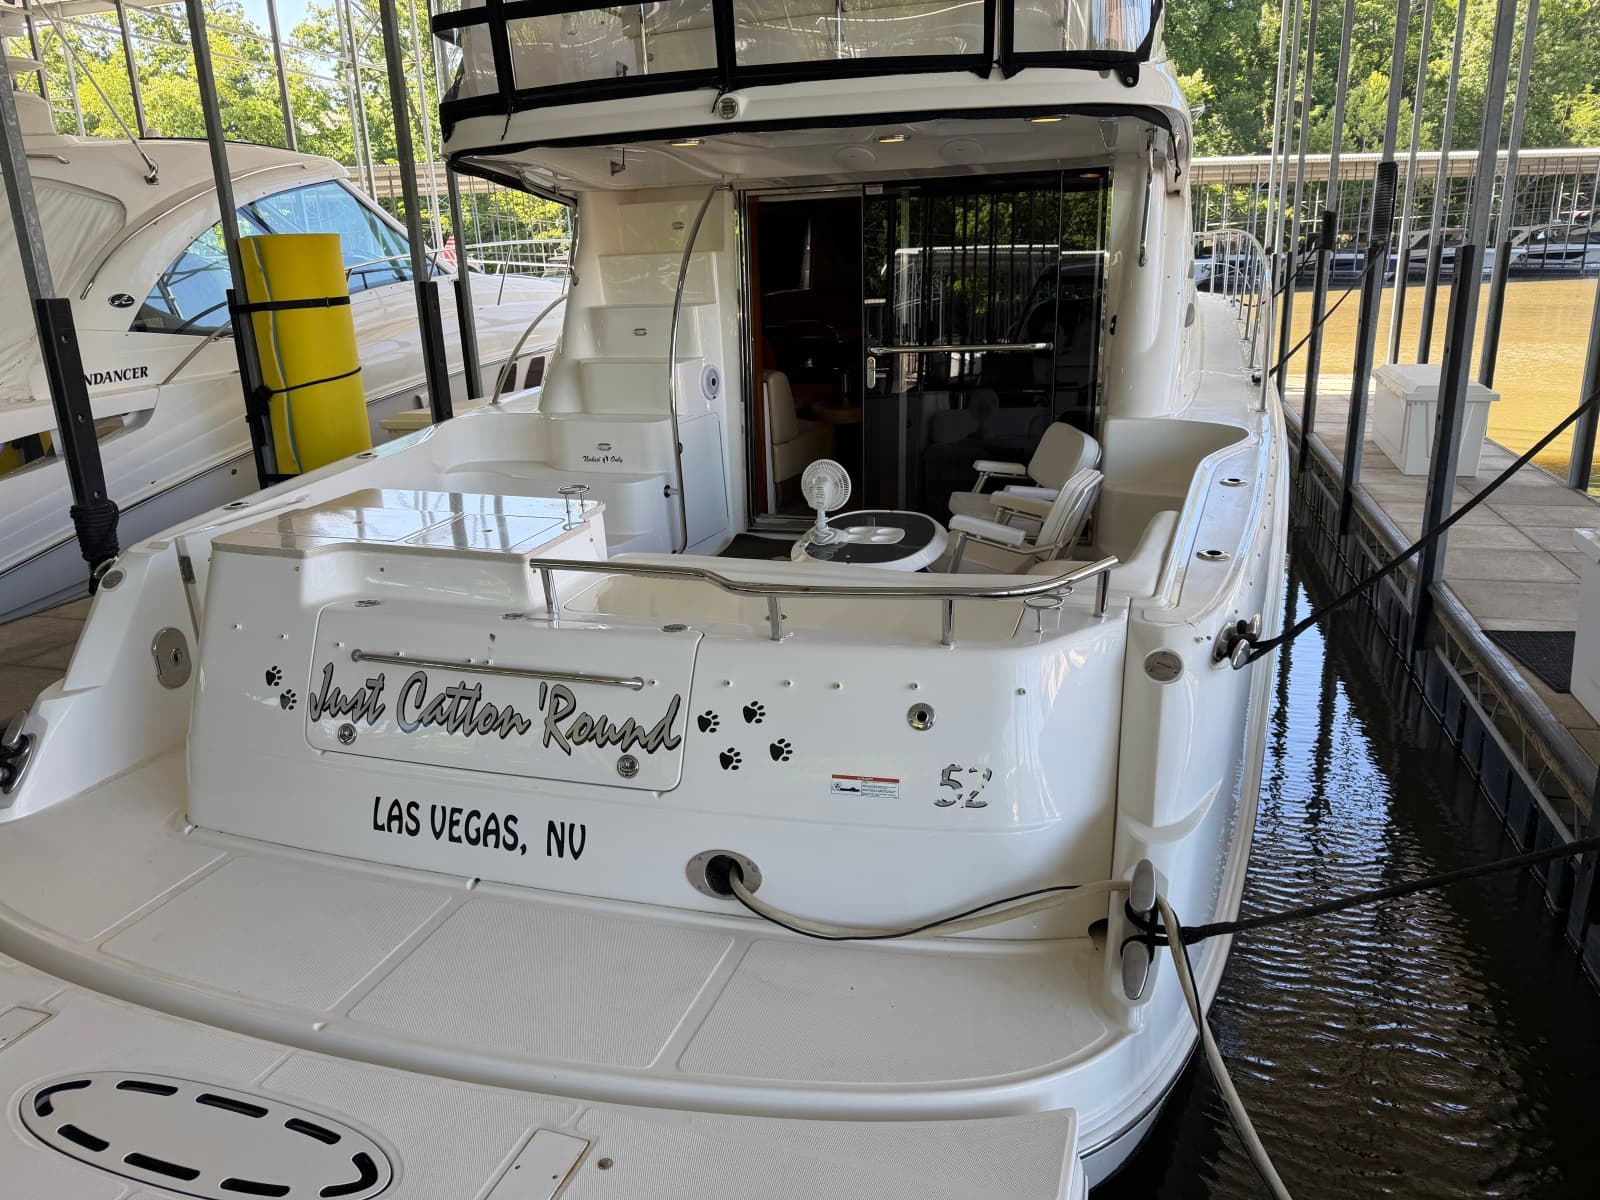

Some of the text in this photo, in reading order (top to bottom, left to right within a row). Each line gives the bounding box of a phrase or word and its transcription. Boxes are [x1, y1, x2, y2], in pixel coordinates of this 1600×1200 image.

[309, 663, 385, 726] Just
[396, 671, 531, 738] Catton
[933, 763, 992, 808] 52
[372, 796, 587, 860] LAS VEGAS, NV
